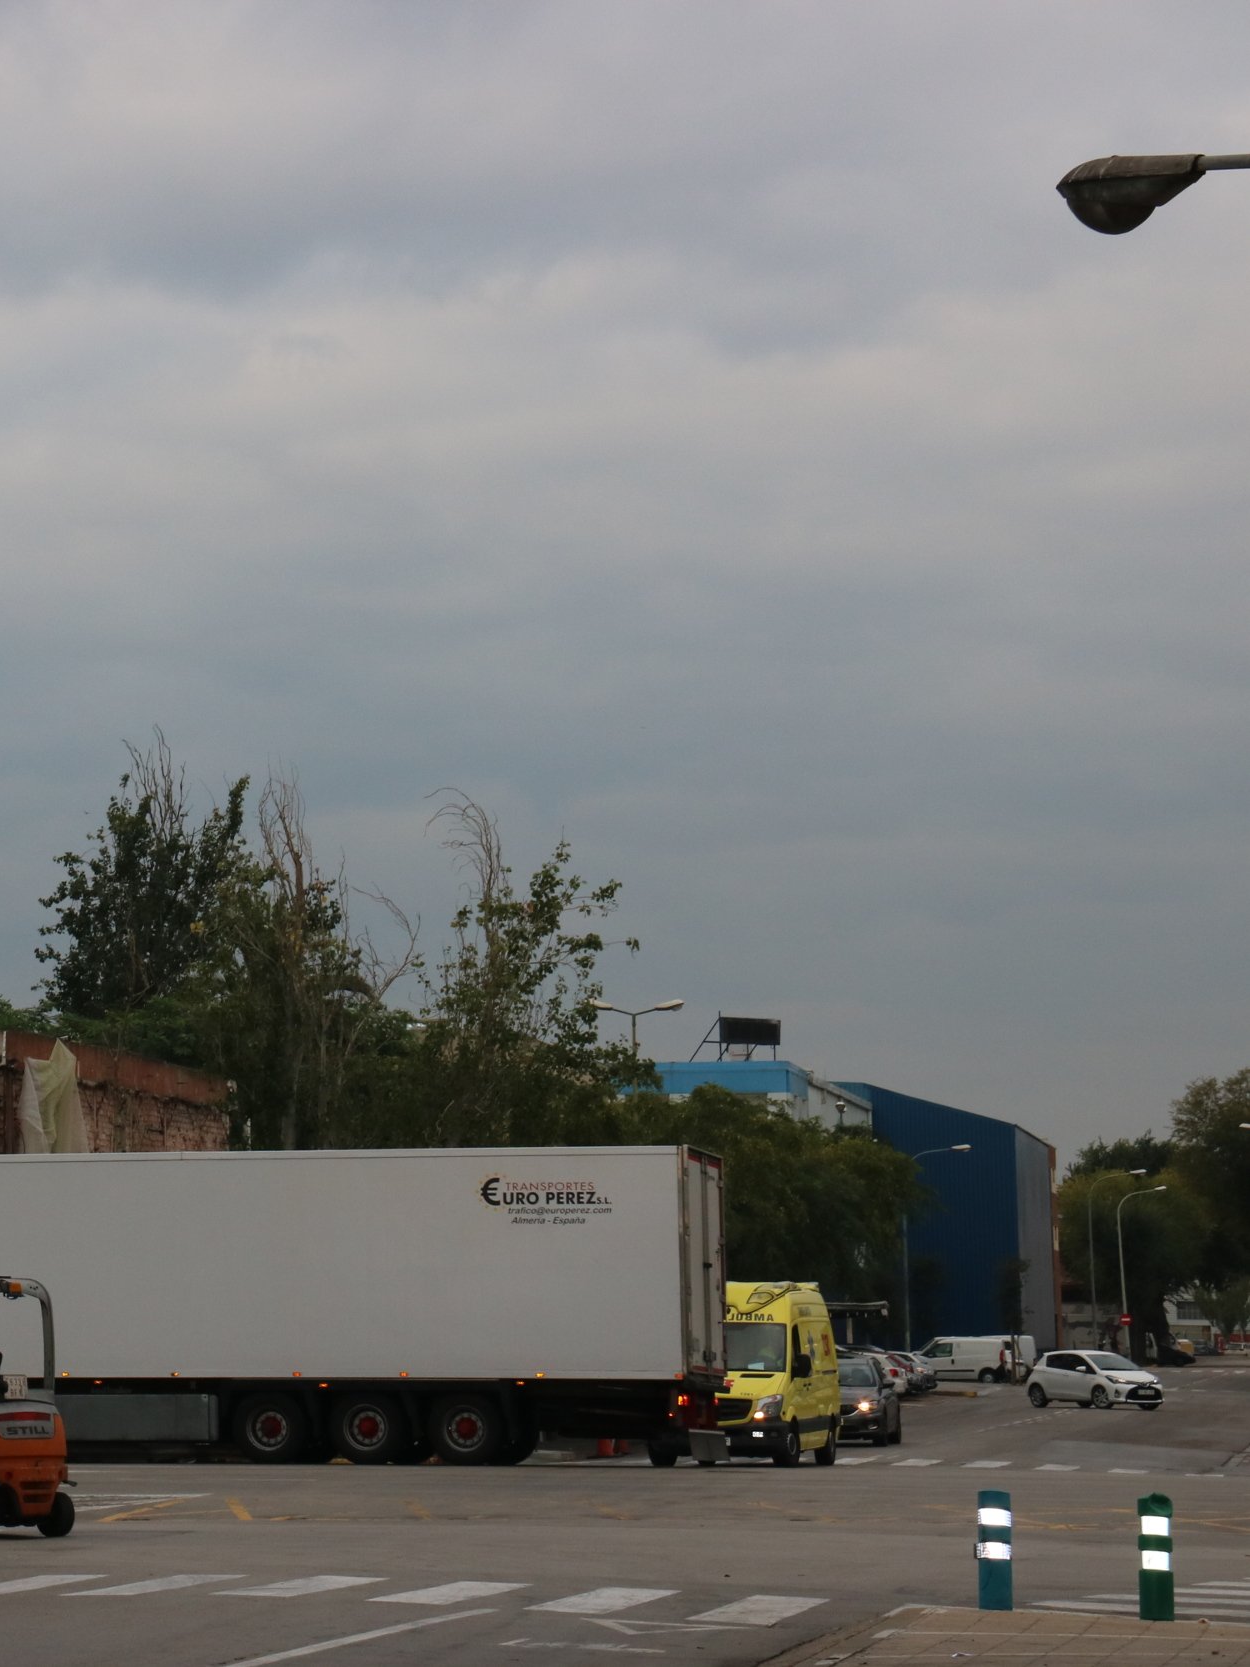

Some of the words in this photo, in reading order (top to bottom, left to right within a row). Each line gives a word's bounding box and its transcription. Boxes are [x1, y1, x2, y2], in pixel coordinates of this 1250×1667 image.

[506, 1182, 595, 1191] TRANSPORTES
[546, 1191, 596, 1205] PEREZ
[597, 1196, 612, 1205] S.L.
[508, 1207, 612, 1216] trafico@europerez.com
[553, 1216, 586, 1226] España
[6, 1425, 49, 1435] STILL
